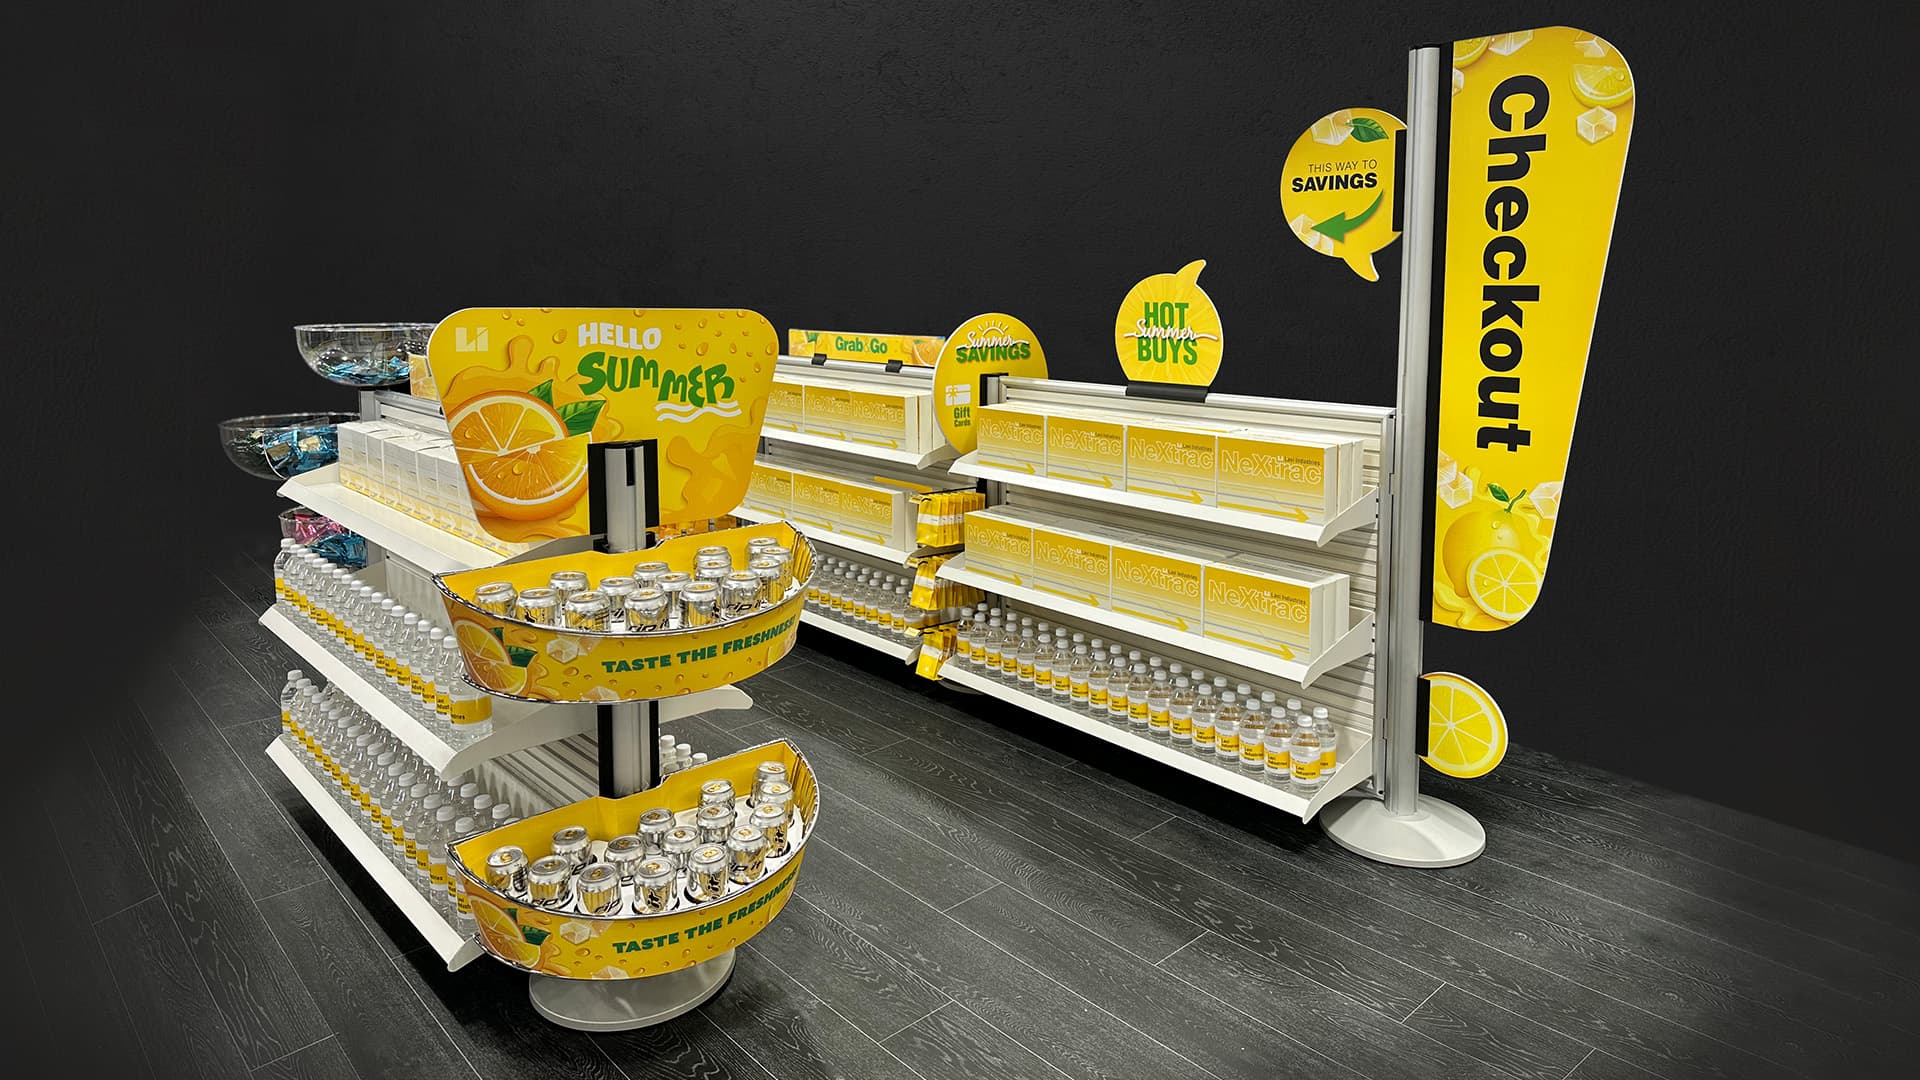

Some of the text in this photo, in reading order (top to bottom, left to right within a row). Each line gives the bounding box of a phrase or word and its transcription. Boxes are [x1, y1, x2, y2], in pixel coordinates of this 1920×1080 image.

[1308, 159, 1378, 173] THIS WAY TO
[1291, 172, 1378, 193] SAVINGS
[1475, 74, 1550, 452] Checkout
[1144, 301, 1189, 329] HOT
[577, 321, 662, 350] HELLO
[835, 335, 864, 352] Grab
[870, 337, 888, 354] Go
[957, 330, 1029, 348] Summer
[1124, 319, 1217, 341] Summer
[956, 343, 1031, 363] SAVINGS
[1138, 337, 1198, 365] BUYS
[577, 351, 735, 408] SUMMER
[953, 407, 971, 418] Gift
[954, 419, 971, 427] Cards
[978, 417, 1043, 445] NeXtrac
[1049, 427, 1122, 457] NeXtrac
[1129, 437, 1214, 469] NeXtrac
[1221, 449, 1322, 485] NeXtrac
[967, 523, 1031, 557] NeXtrac
[1036, 541, 1108, 576] NeXtrac
[1115, 558, 1199, 599] NeXtrac
[1208, 579, 1307, 623] NeXtrac
[601, 653, 671, 674] TASTE
[676, 645, 718, 664] THE
[612, 931, 680, 954] TASTE
[684, 917, 723, 940] THE
